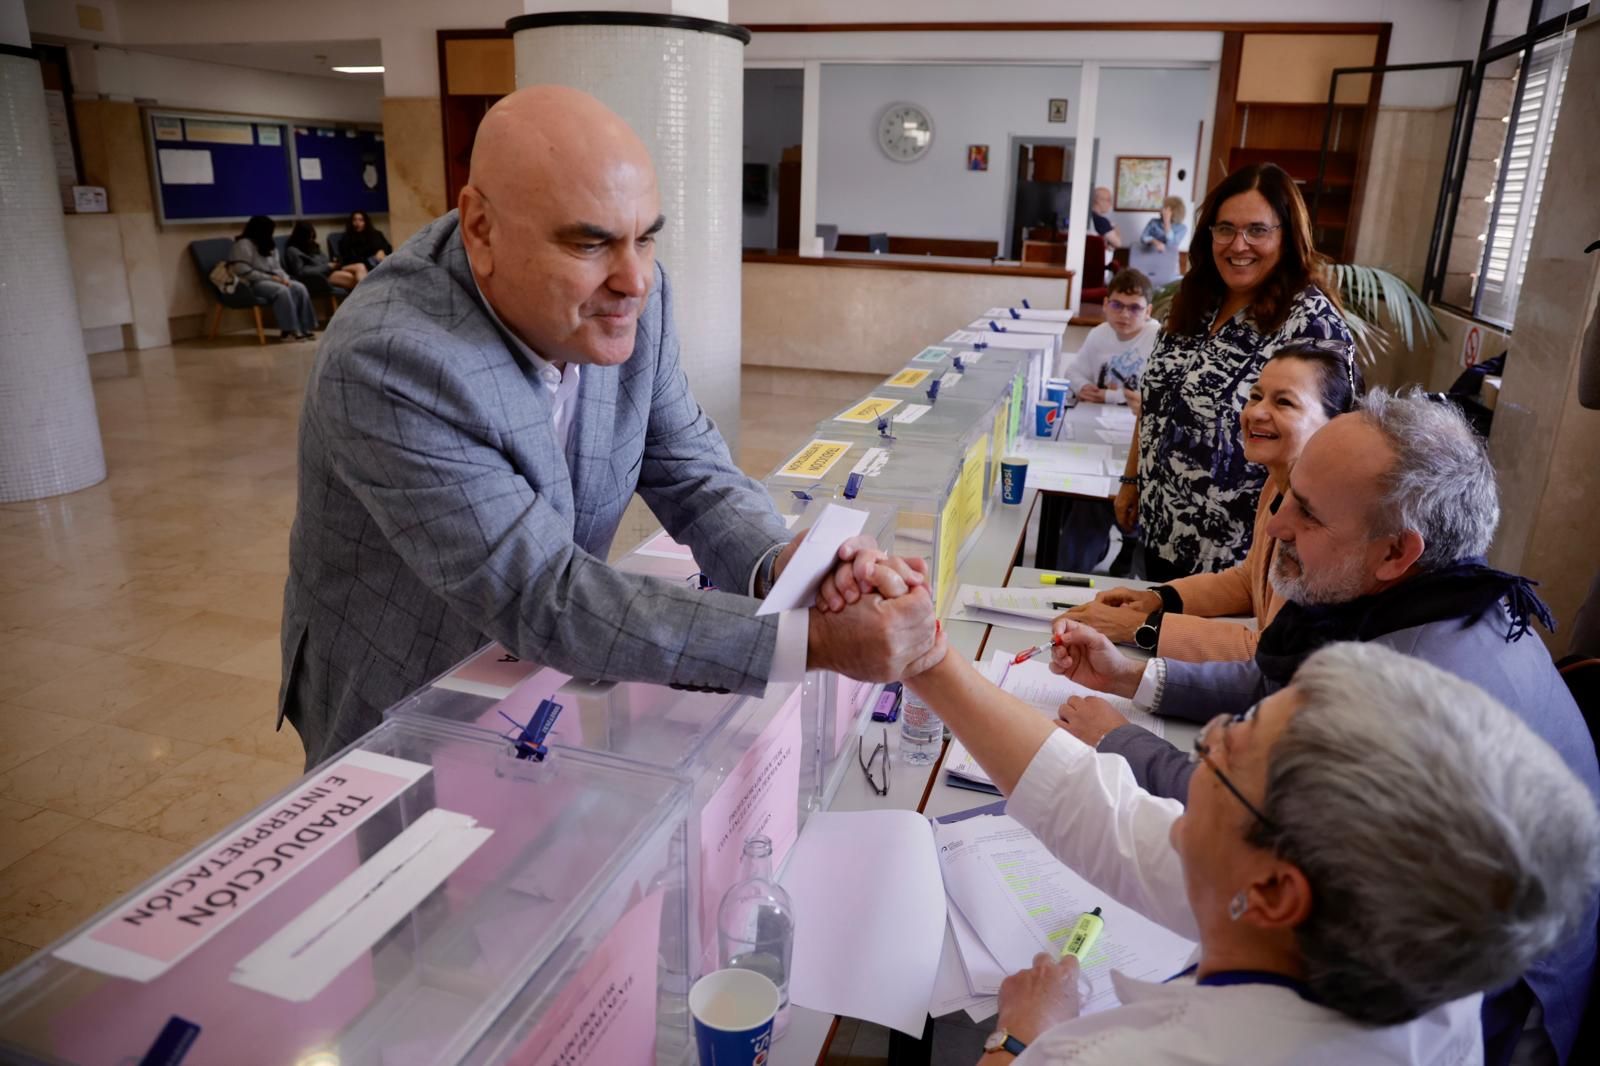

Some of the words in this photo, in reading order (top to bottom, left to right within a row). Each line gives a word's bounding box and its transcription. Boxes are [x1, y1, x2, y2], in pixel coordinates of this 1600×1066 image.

[1004, 469, 1014, 500] pepsi
[324, 775, 348, 787] E
[122, 786, 332, 926] INTERPRETACIÓN
[177, 794, 373, 926] TRADUCCIÓN
